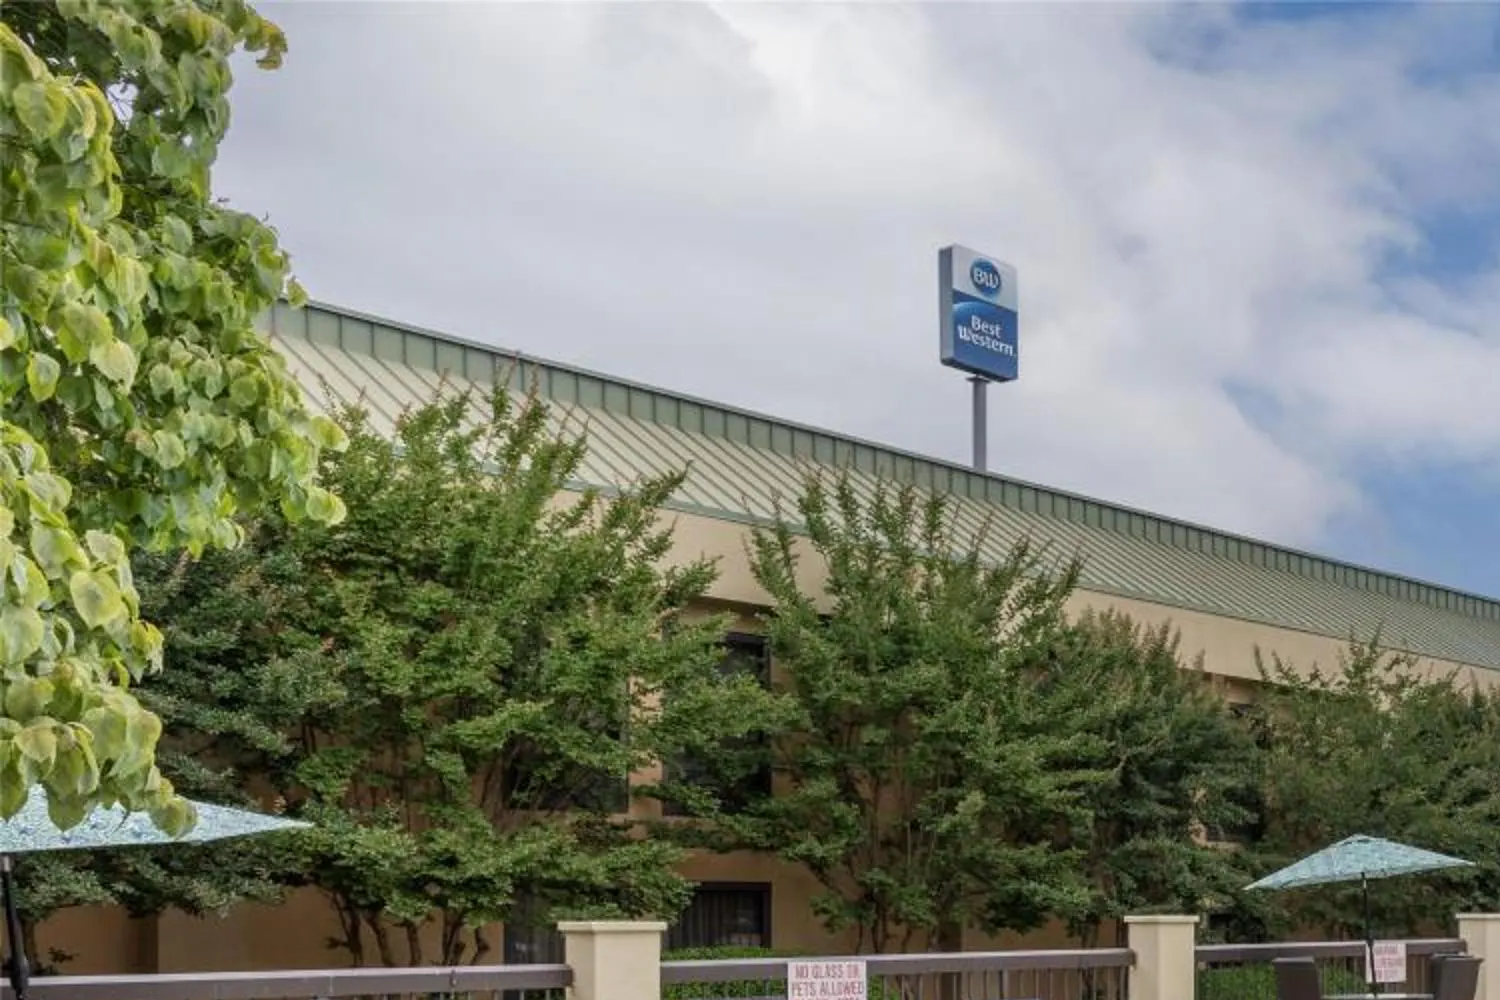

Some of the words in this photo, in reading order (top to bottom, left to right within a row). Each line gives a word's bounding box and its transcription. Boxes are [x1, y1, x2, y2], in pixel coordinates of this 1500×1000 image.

[973, 266, 999, 289] BW
[971, 314, 1001, 338] Best
[957, 324, 1014, 357] Western
[795, 964, 809, 978] NO
[812, 964, 843, 978] GLASS
[791, 981, 816, 996] PETS
[820, 981, 864, 996] ALLOWED
